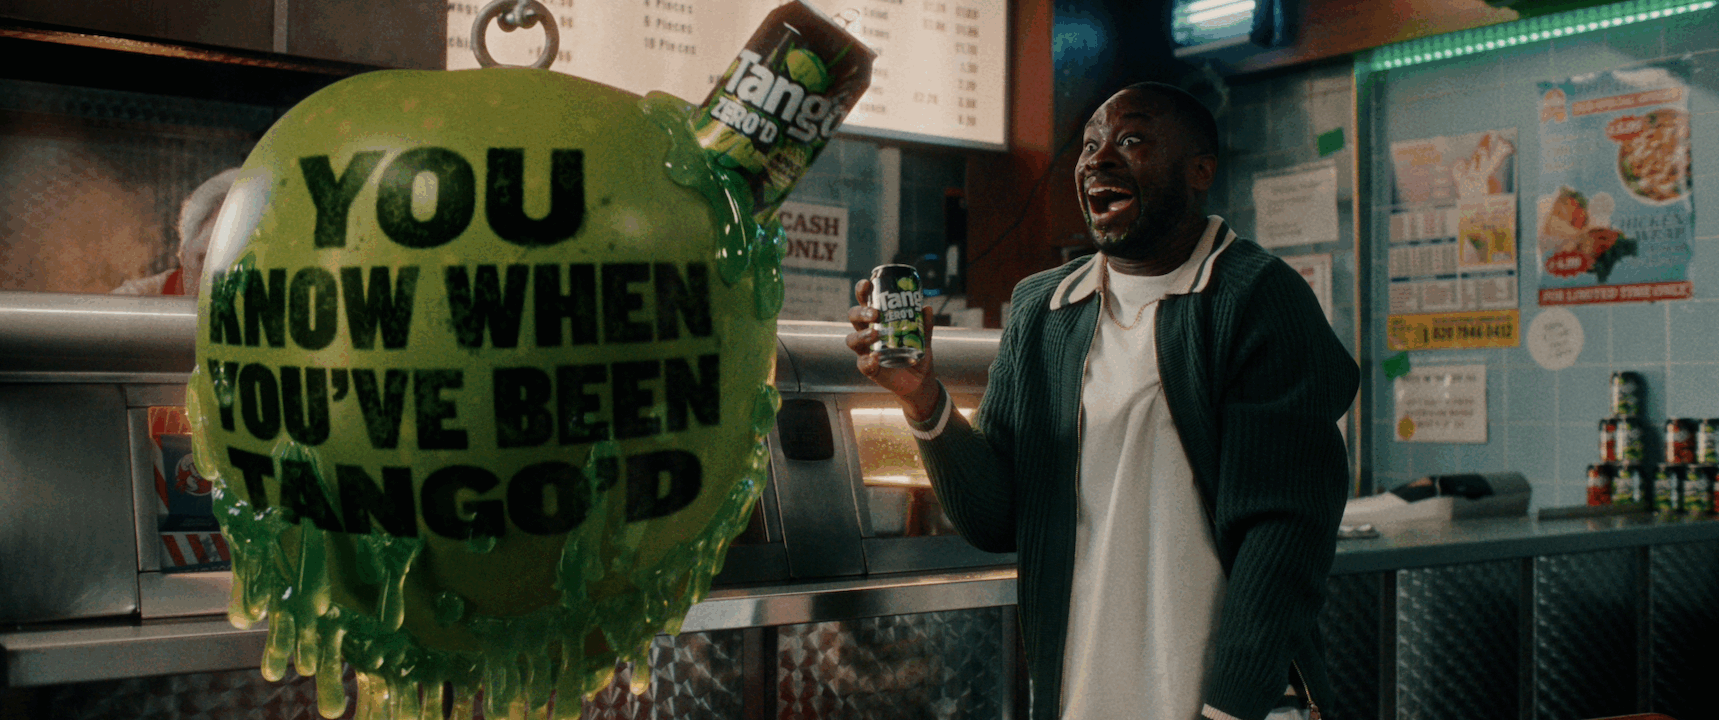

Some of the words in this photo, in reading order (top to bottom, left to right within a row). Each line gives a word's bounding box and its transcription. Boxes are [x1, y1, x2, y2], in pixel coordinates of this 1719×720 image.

[711, 96, 778, 144] ZERO'D
[725, 49, 845, 143] Tango
[299, 147, 585, 249] YOU
[778, 211, 840, 236] CASH
[209, 265, 420, 350] KNOW
[444, 262, 713, 348] WHEN
[884, 310, 914, 322] ZERO'D
[207, 358, 468, 450] YOU'VE
[493, 353, 721, 449] BEEN
[227, 449, 703, 539] TANGO'D
